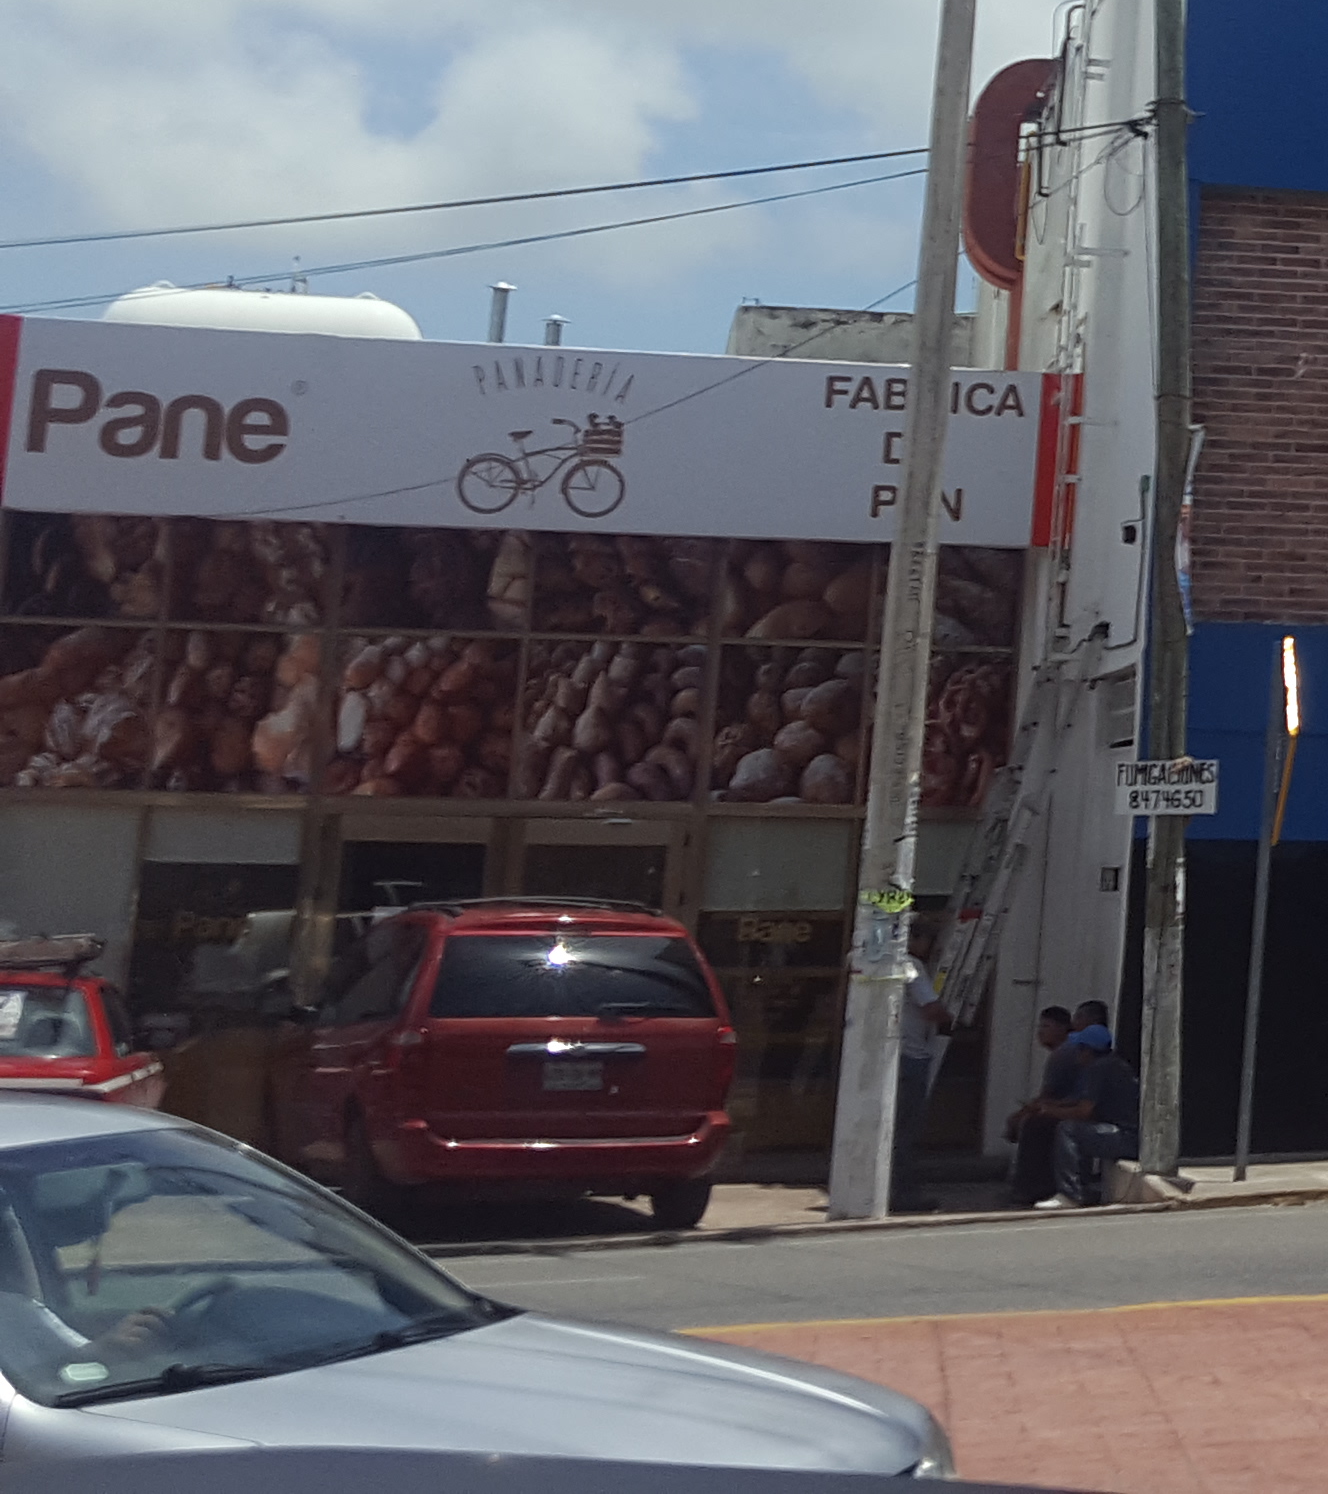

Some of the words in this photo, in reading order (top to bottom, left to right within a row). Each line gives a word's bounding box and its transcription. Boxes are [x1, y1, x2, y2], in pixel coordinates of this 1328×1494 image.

[26, 368, 290, 464] Pane
[824, 375, 1025, 418] FABICA
[869, 484, 963, 522] PN
[1128, 789, 1204, 809] 8474650
